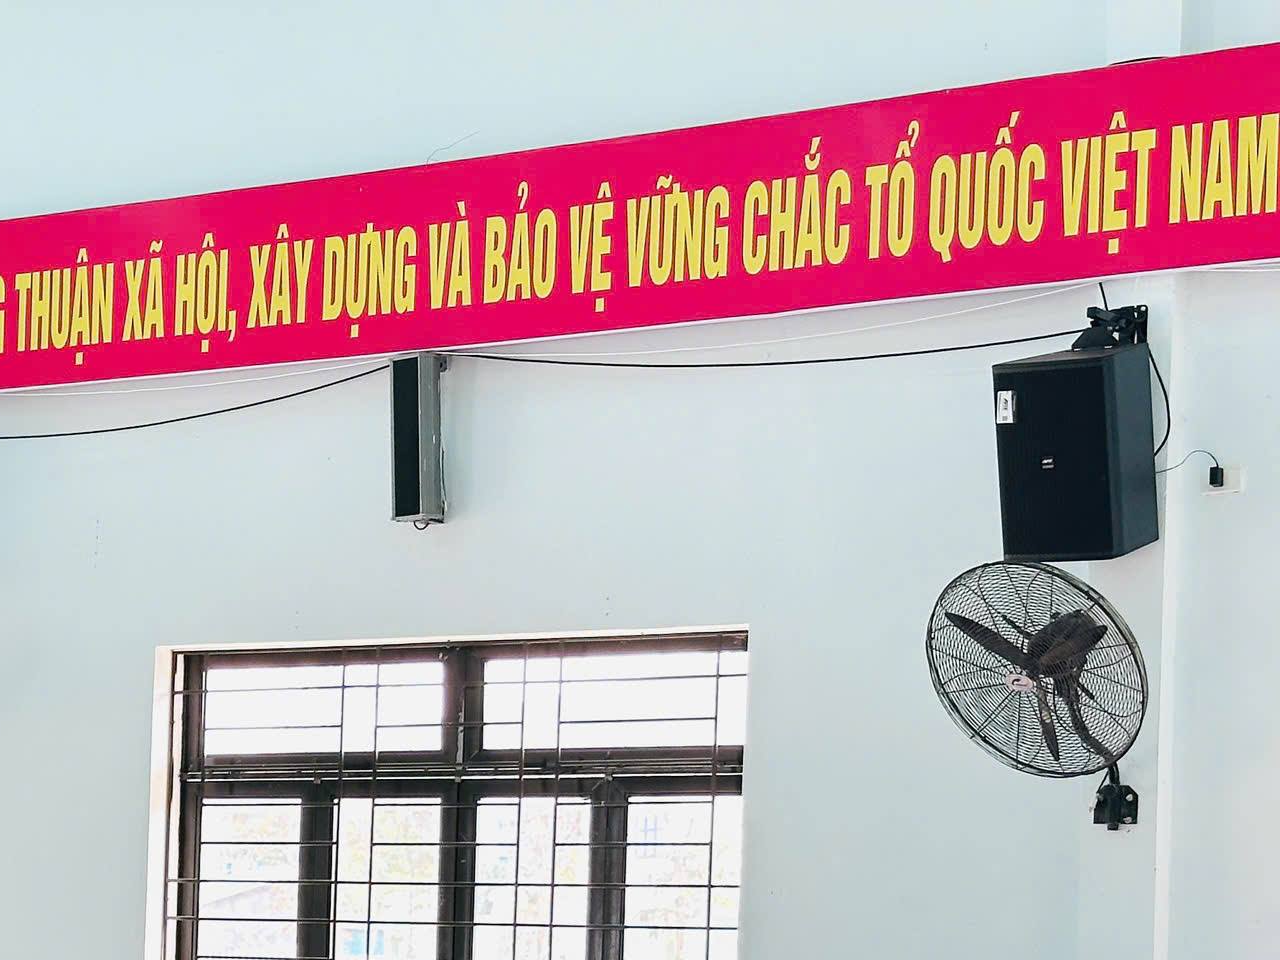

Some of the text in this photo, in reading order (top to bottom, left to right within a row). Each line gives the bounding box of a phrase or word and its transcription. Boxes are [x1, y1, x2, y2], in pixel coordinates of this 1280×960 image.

[15, 248, 115, 365] THUẬN
[122, 240, 165, 342] XÃ
[174, 233, 237, 352] HỘI,
[247, 224, 314, 328] XÂY
[322, 222, 417, 338] DỰNG
[428, 201, 472, 309] VÀ
[483, 181, 558, 304] BẢO
[569, 182, 614, 312] VỆ
[627, 175, 730, 288] VỮNG
[742, 137, 852, 275] CHẮC
[865, 120, 921, 259] TỔ
[928, 111, 1046, 263] QUỐC
[1061, 111, 1157, 254] VIỆT
[1169, 113, 1280, 224] NAM
